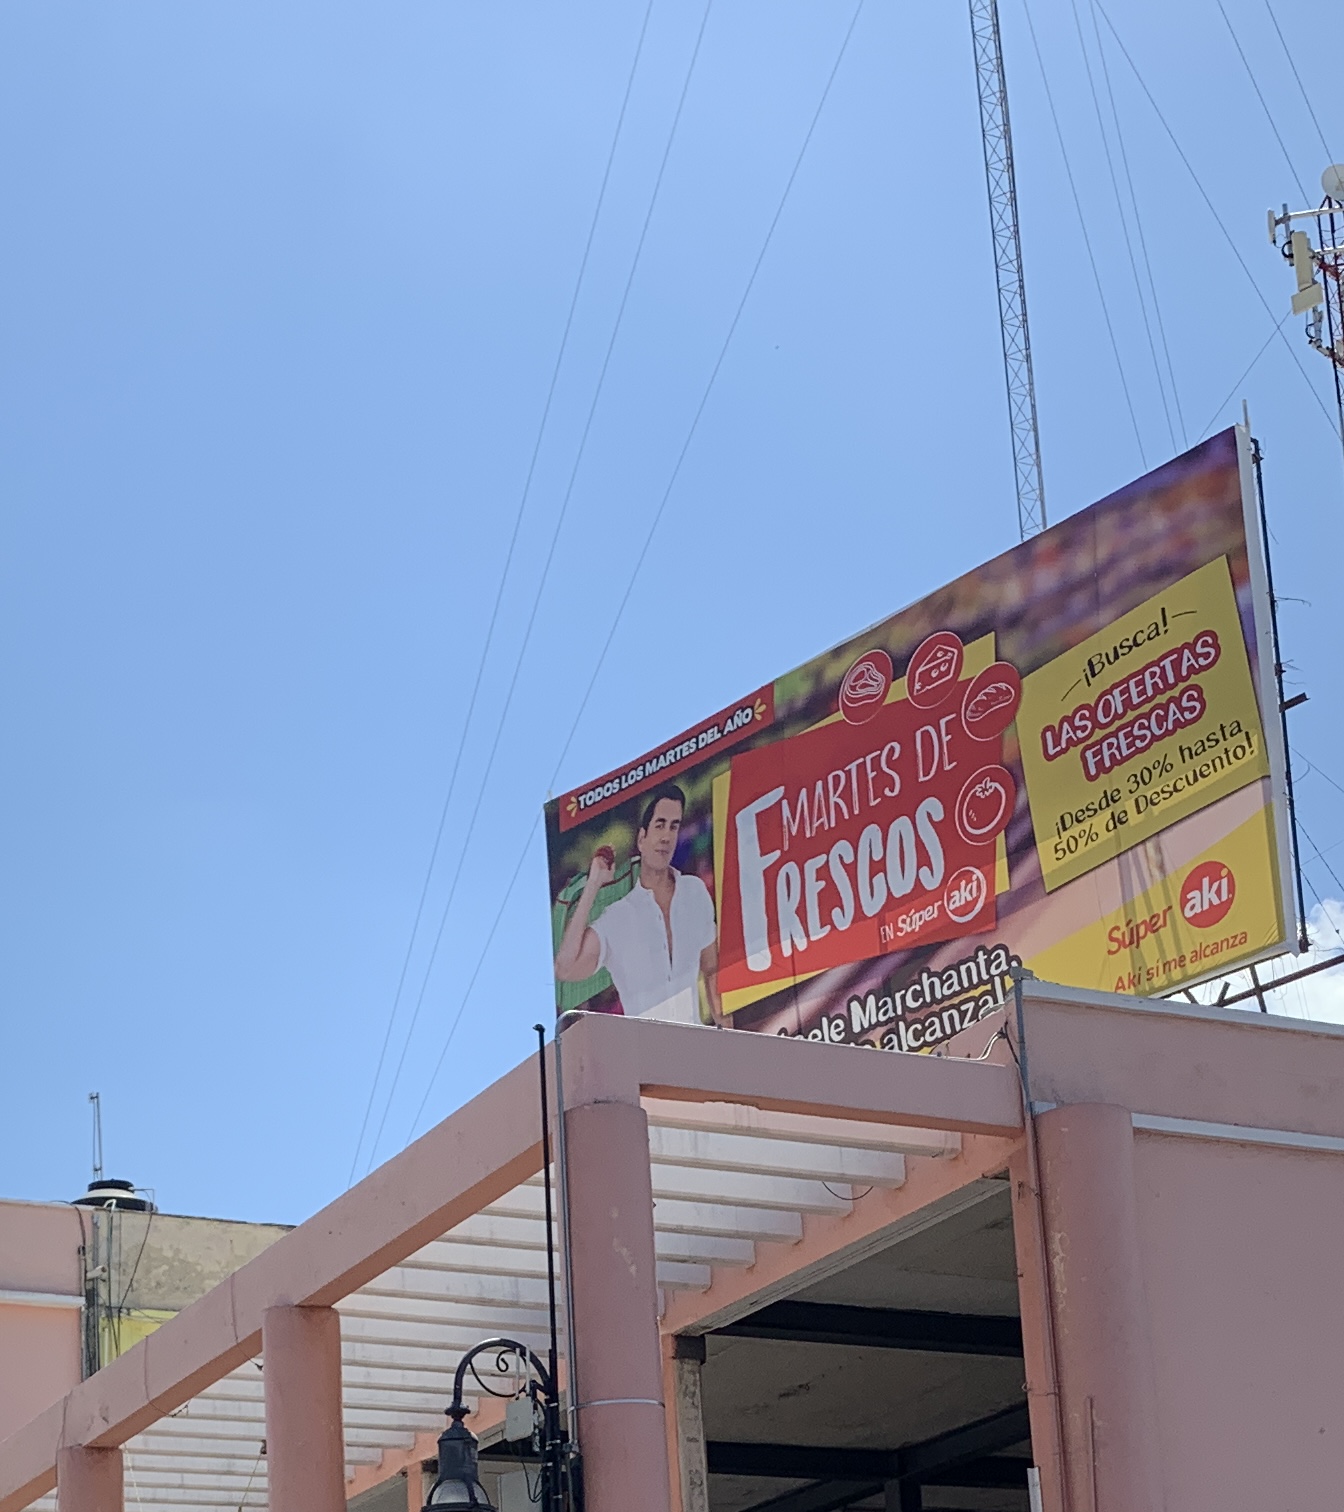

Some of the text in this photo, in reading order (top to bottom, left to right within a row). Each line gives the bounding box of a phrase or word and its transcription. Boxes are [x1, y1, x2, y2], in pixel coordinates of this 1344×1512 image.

[1045, 635, 1217, 756] LAS OFERTAS
[1082, 607, 1168, 687] ¡Busca!
[578, 707, 754, 809] TODOS LOS MARTES DEL AÑO
[781, 713, 957, 851] MARTES DE
[1056, 719, 1243, 847] ¡Desde 30% hasta
[1084, 690, 1202, 776] FRESCAS
[1053, 730, 1255, 862] 50% de Descuento!
[735, 786, 945, 972] FRESCOS
[880, 874, 978, 943] EN Súper aki
[1107, 867, 1230, 956] Súper aki
[1163, 954, 1186, 975] me
[1190, 931, 1248, 964] alcanza
